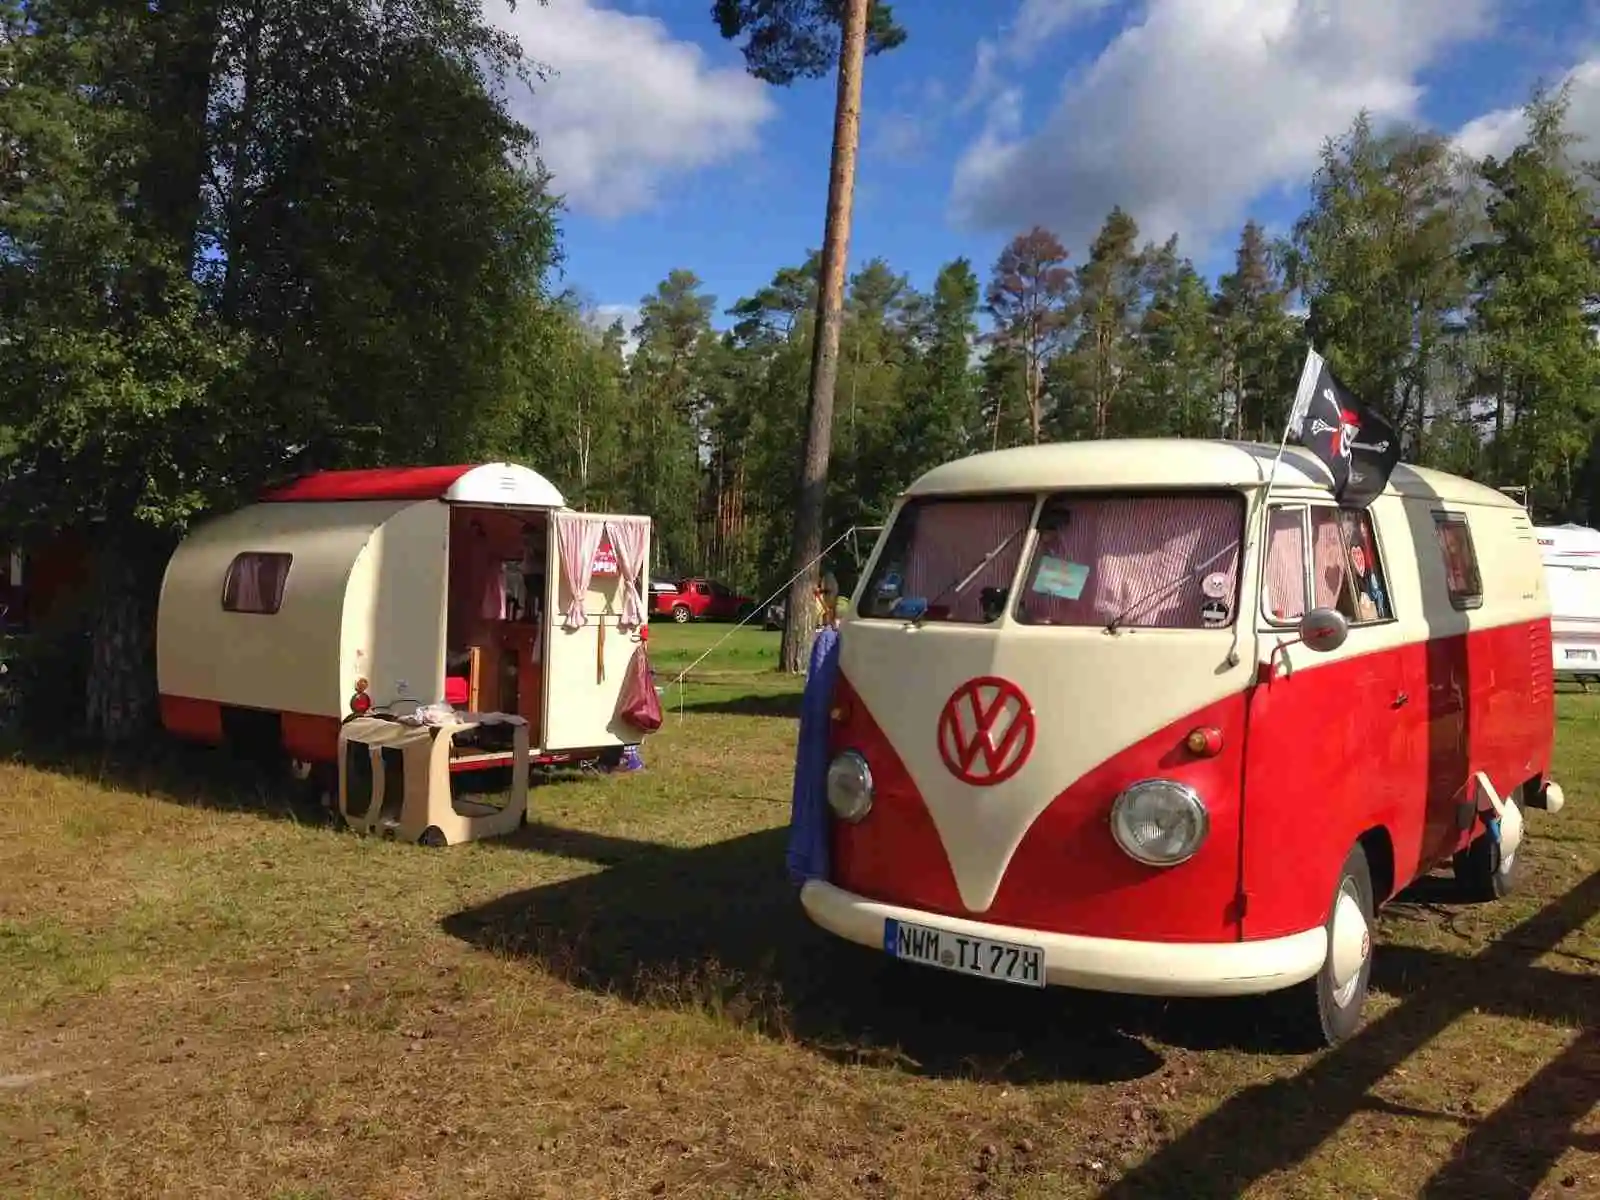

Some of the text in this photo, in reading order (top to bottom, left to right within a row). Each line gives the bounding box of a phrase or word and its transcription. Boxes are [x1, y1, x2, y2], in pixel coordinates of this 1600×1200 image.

[938, 676, 1036, 786] VW
[898, 926, 1039, 981] NWM TI 77H
